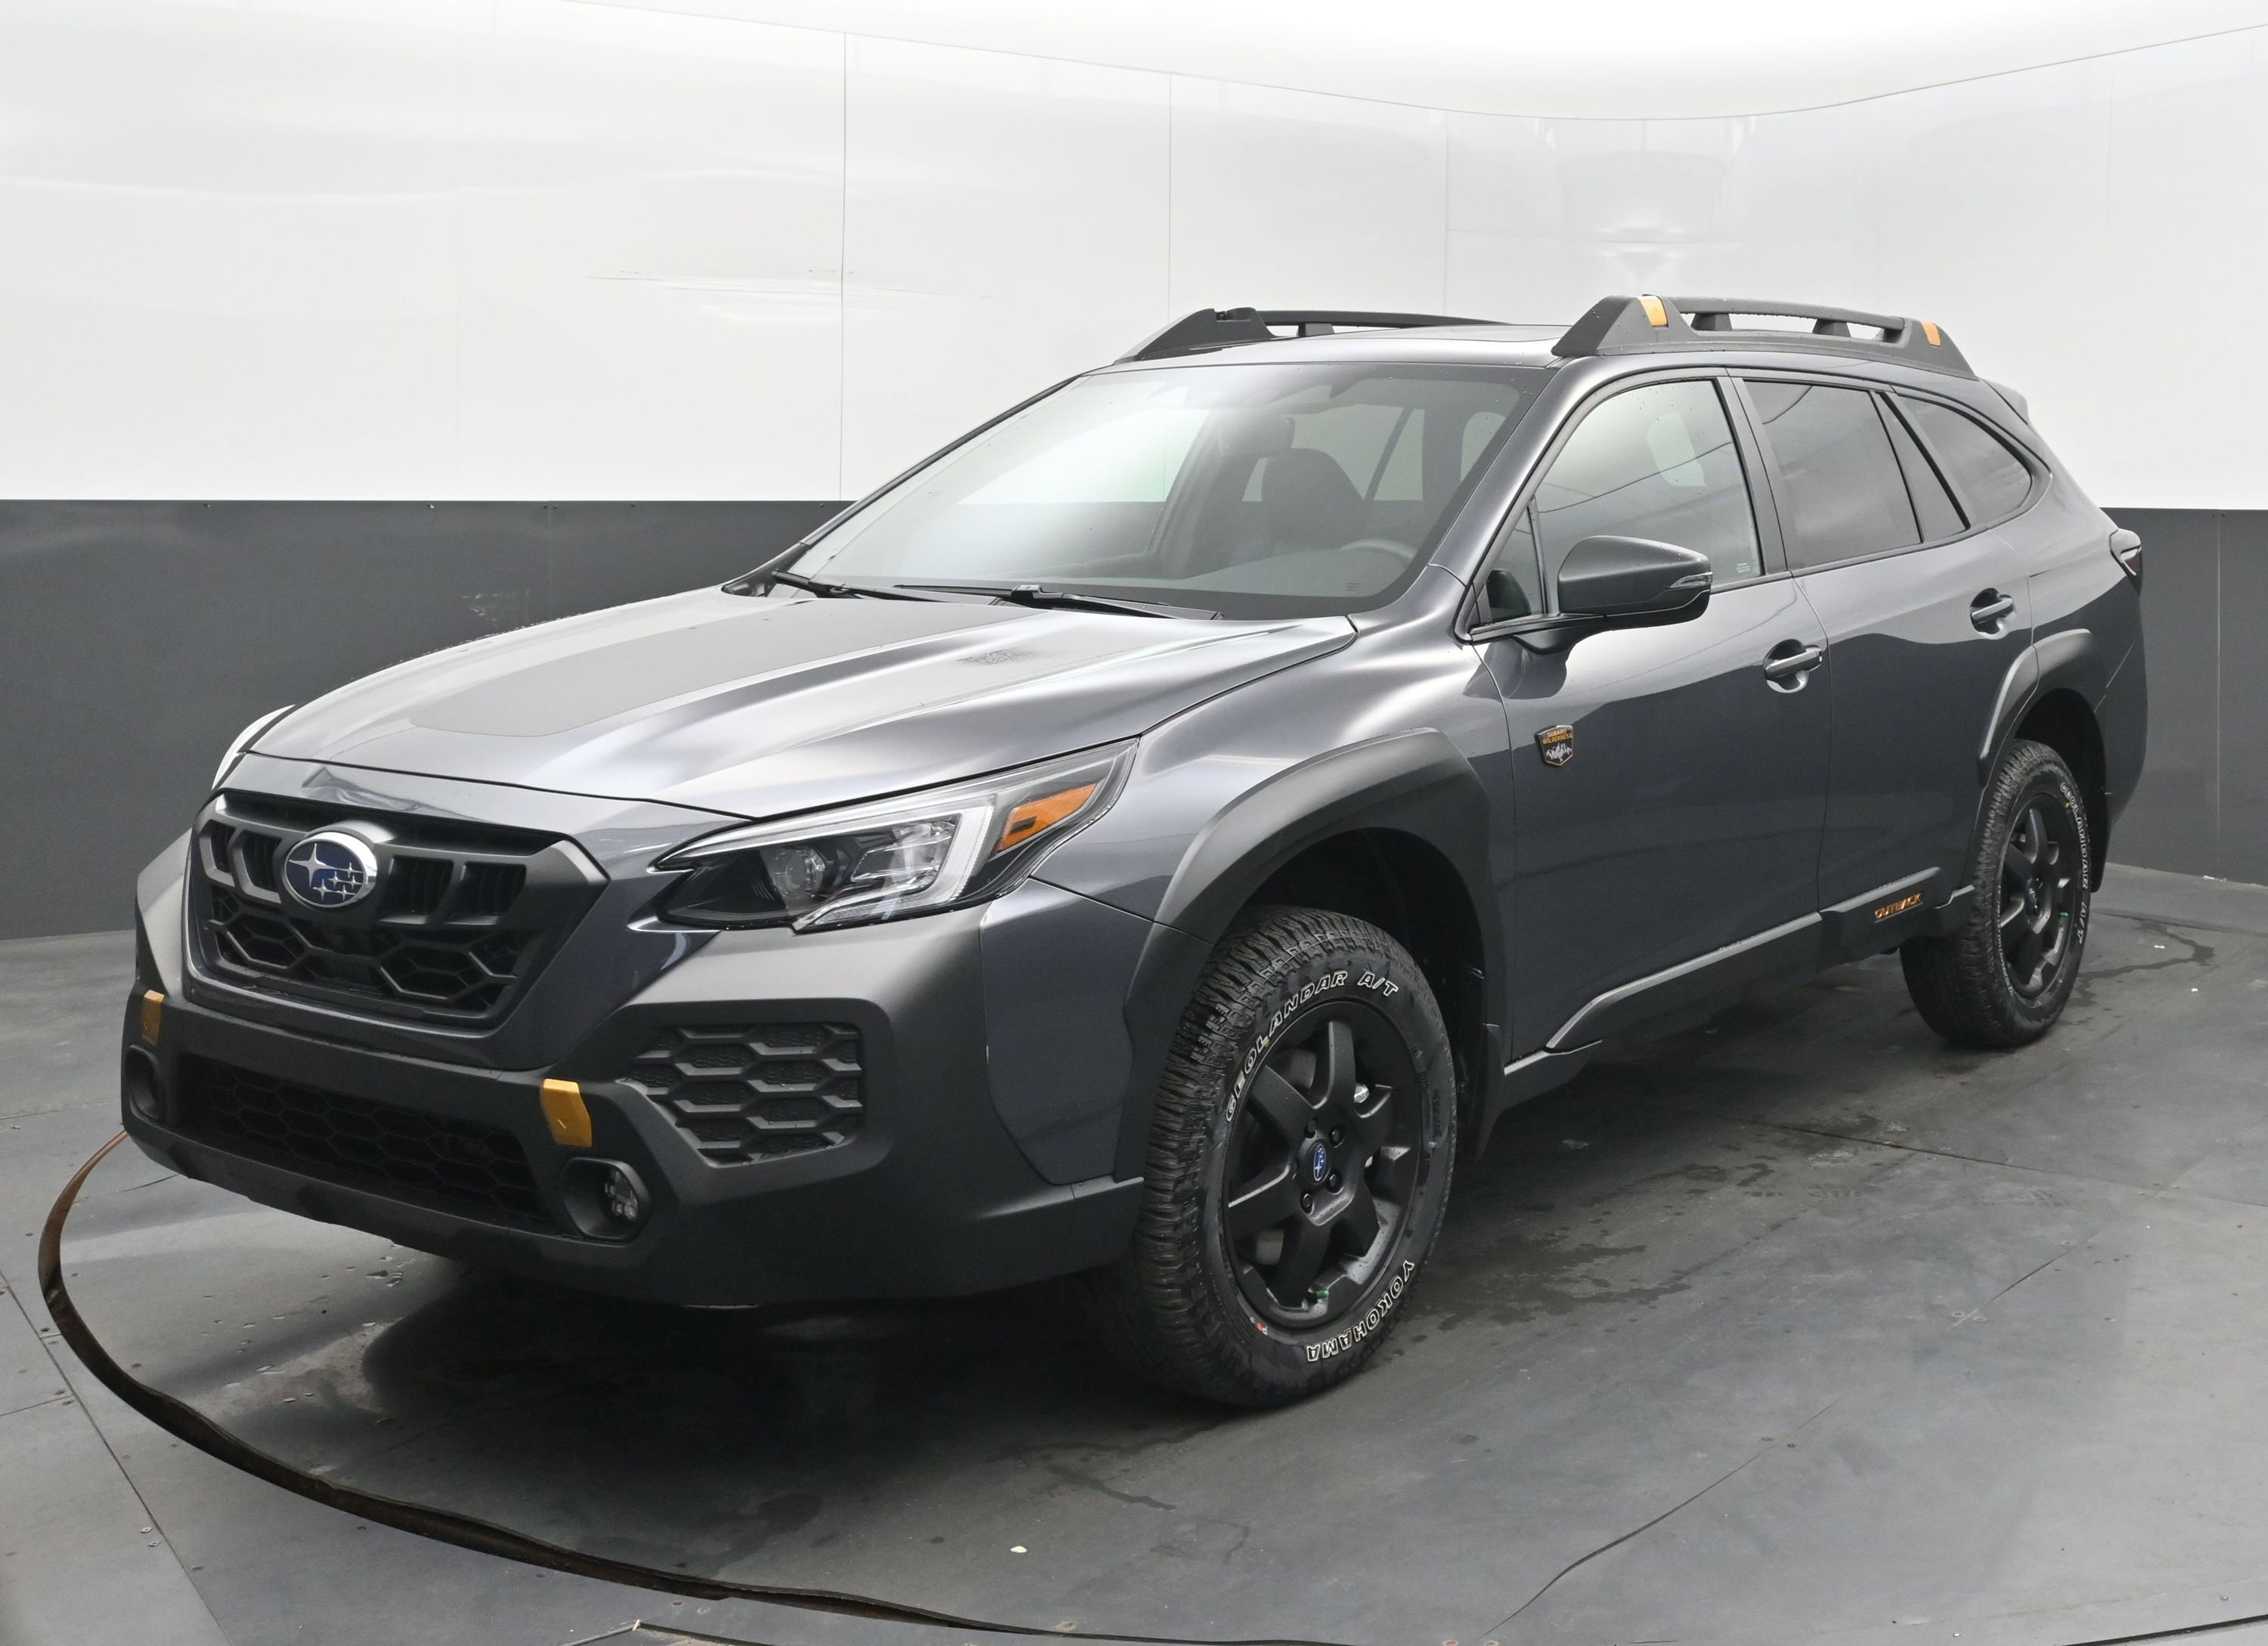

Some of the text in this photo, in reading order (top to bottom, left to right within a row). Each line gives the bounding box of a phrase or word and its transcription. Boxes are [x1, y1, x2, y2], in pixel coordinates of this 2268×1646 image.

[1225, 971, 1399, 1121] GEOLANDAR A/T
[1306, 1260, 1414, 1362] YOKOHAMA
